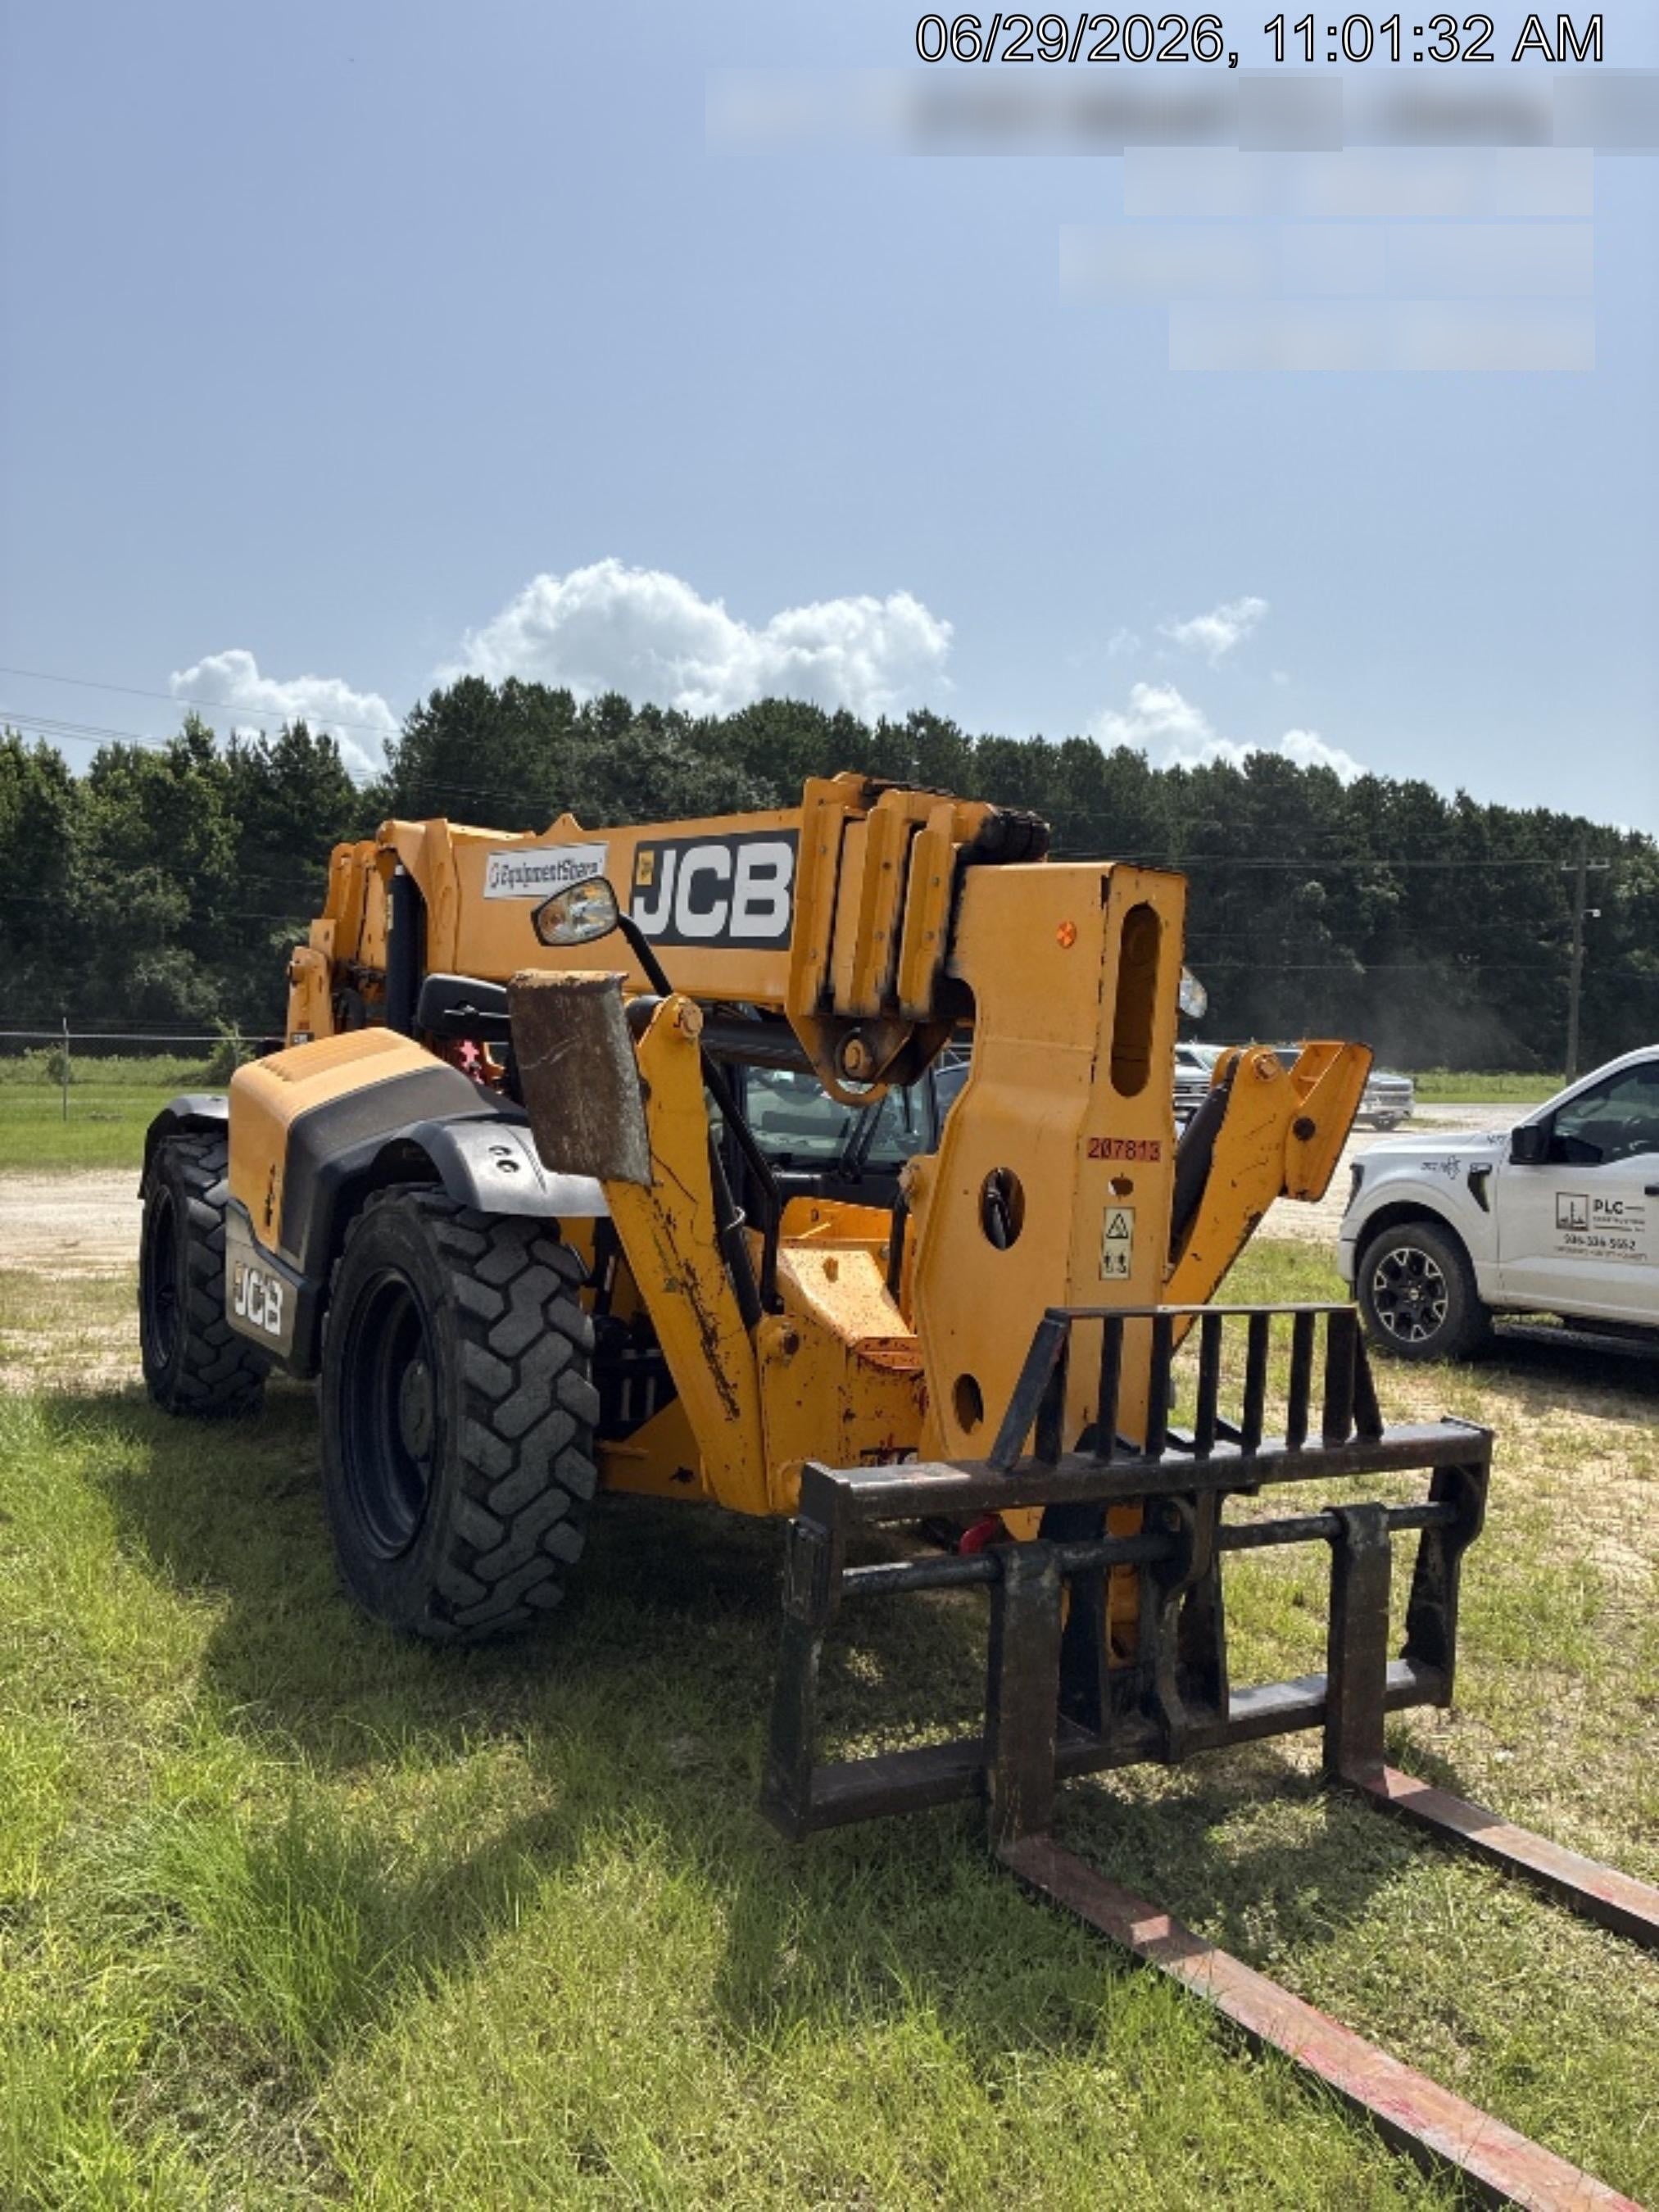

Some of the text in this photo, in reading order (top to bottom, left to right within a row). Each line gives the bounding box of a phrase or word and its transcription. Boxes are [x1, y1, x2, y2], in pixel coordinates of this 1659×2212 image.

[633, 842, 794, 937] JCB
[1088, 1137, 1160, 1161] 207813
[1593, 1199, 1624, 1214] PLC
[234, 1267, 283, 1336] JCB
